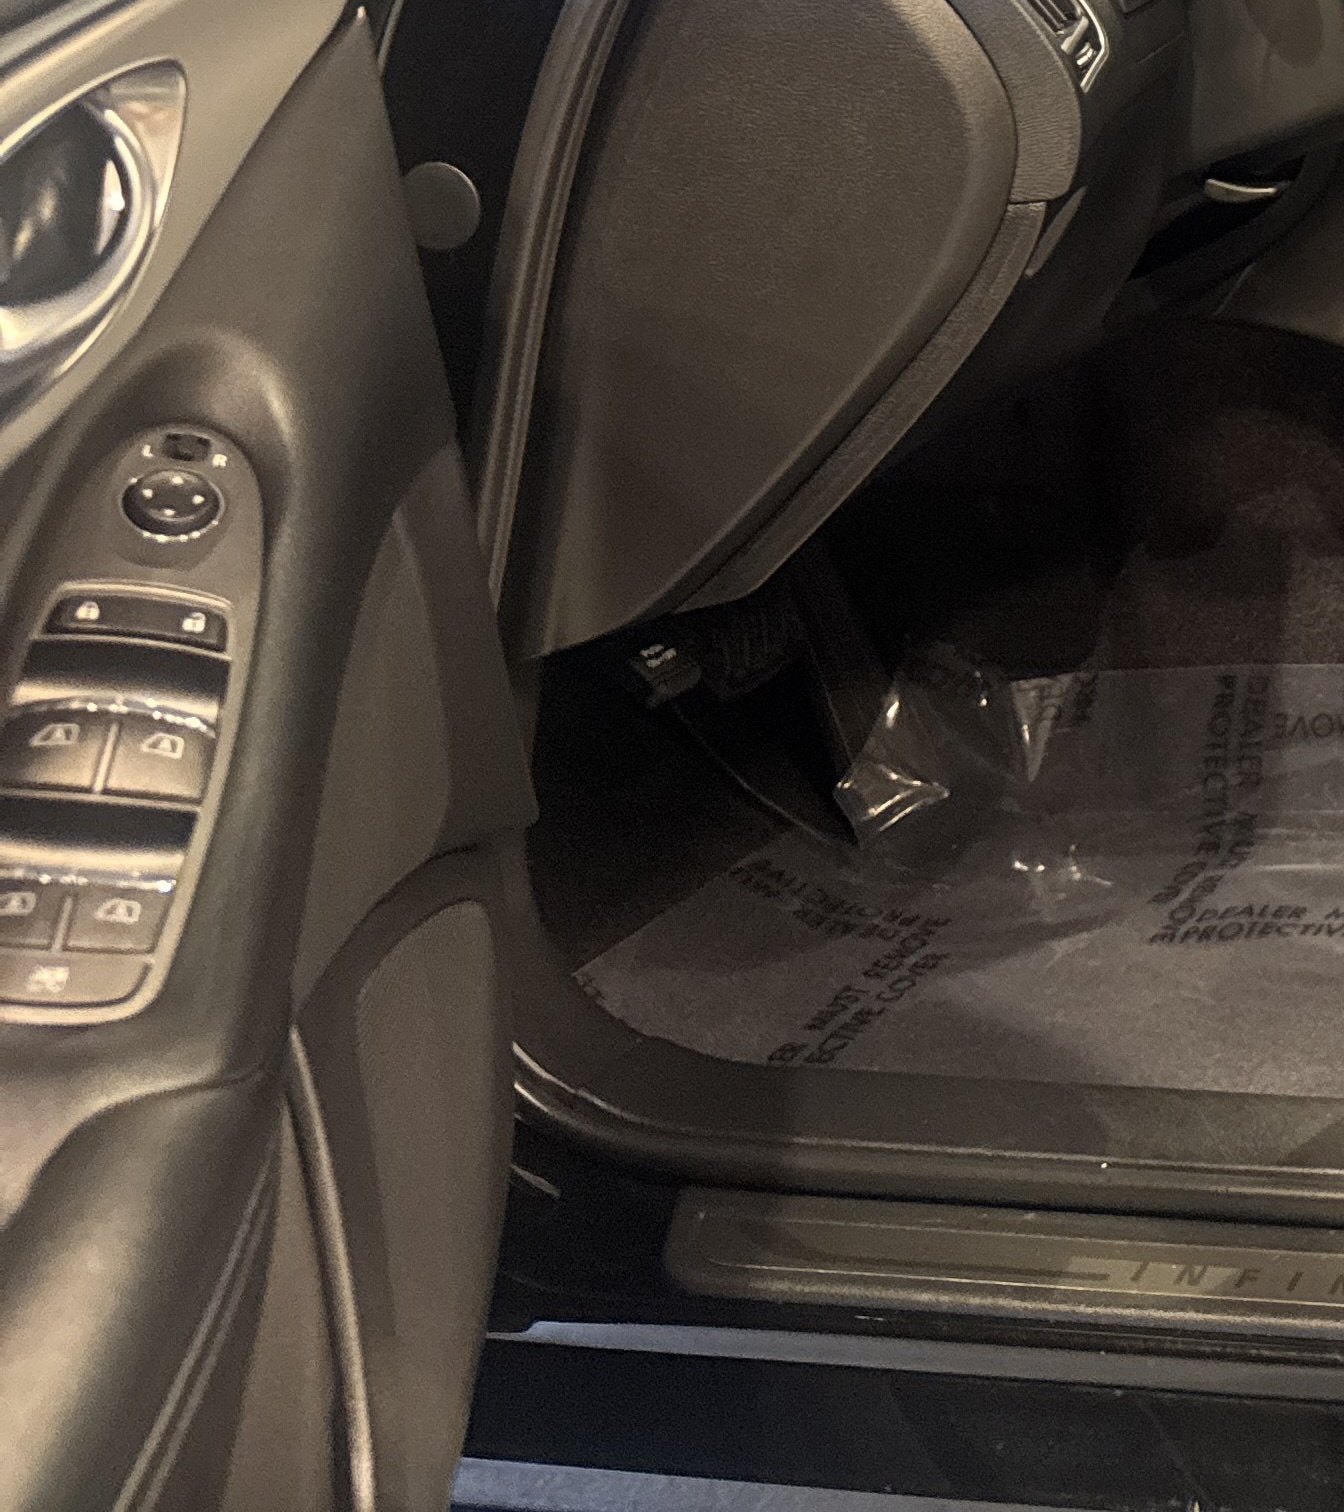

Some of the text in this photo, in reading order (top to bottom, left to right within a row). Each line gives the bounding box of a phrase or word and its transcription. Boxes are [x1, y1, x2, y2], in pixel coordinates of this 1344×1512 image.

[141, 443, 154, 459] L
[212, 453, 229, 468] R
[1196, 903, 1309, 923] DEALER
